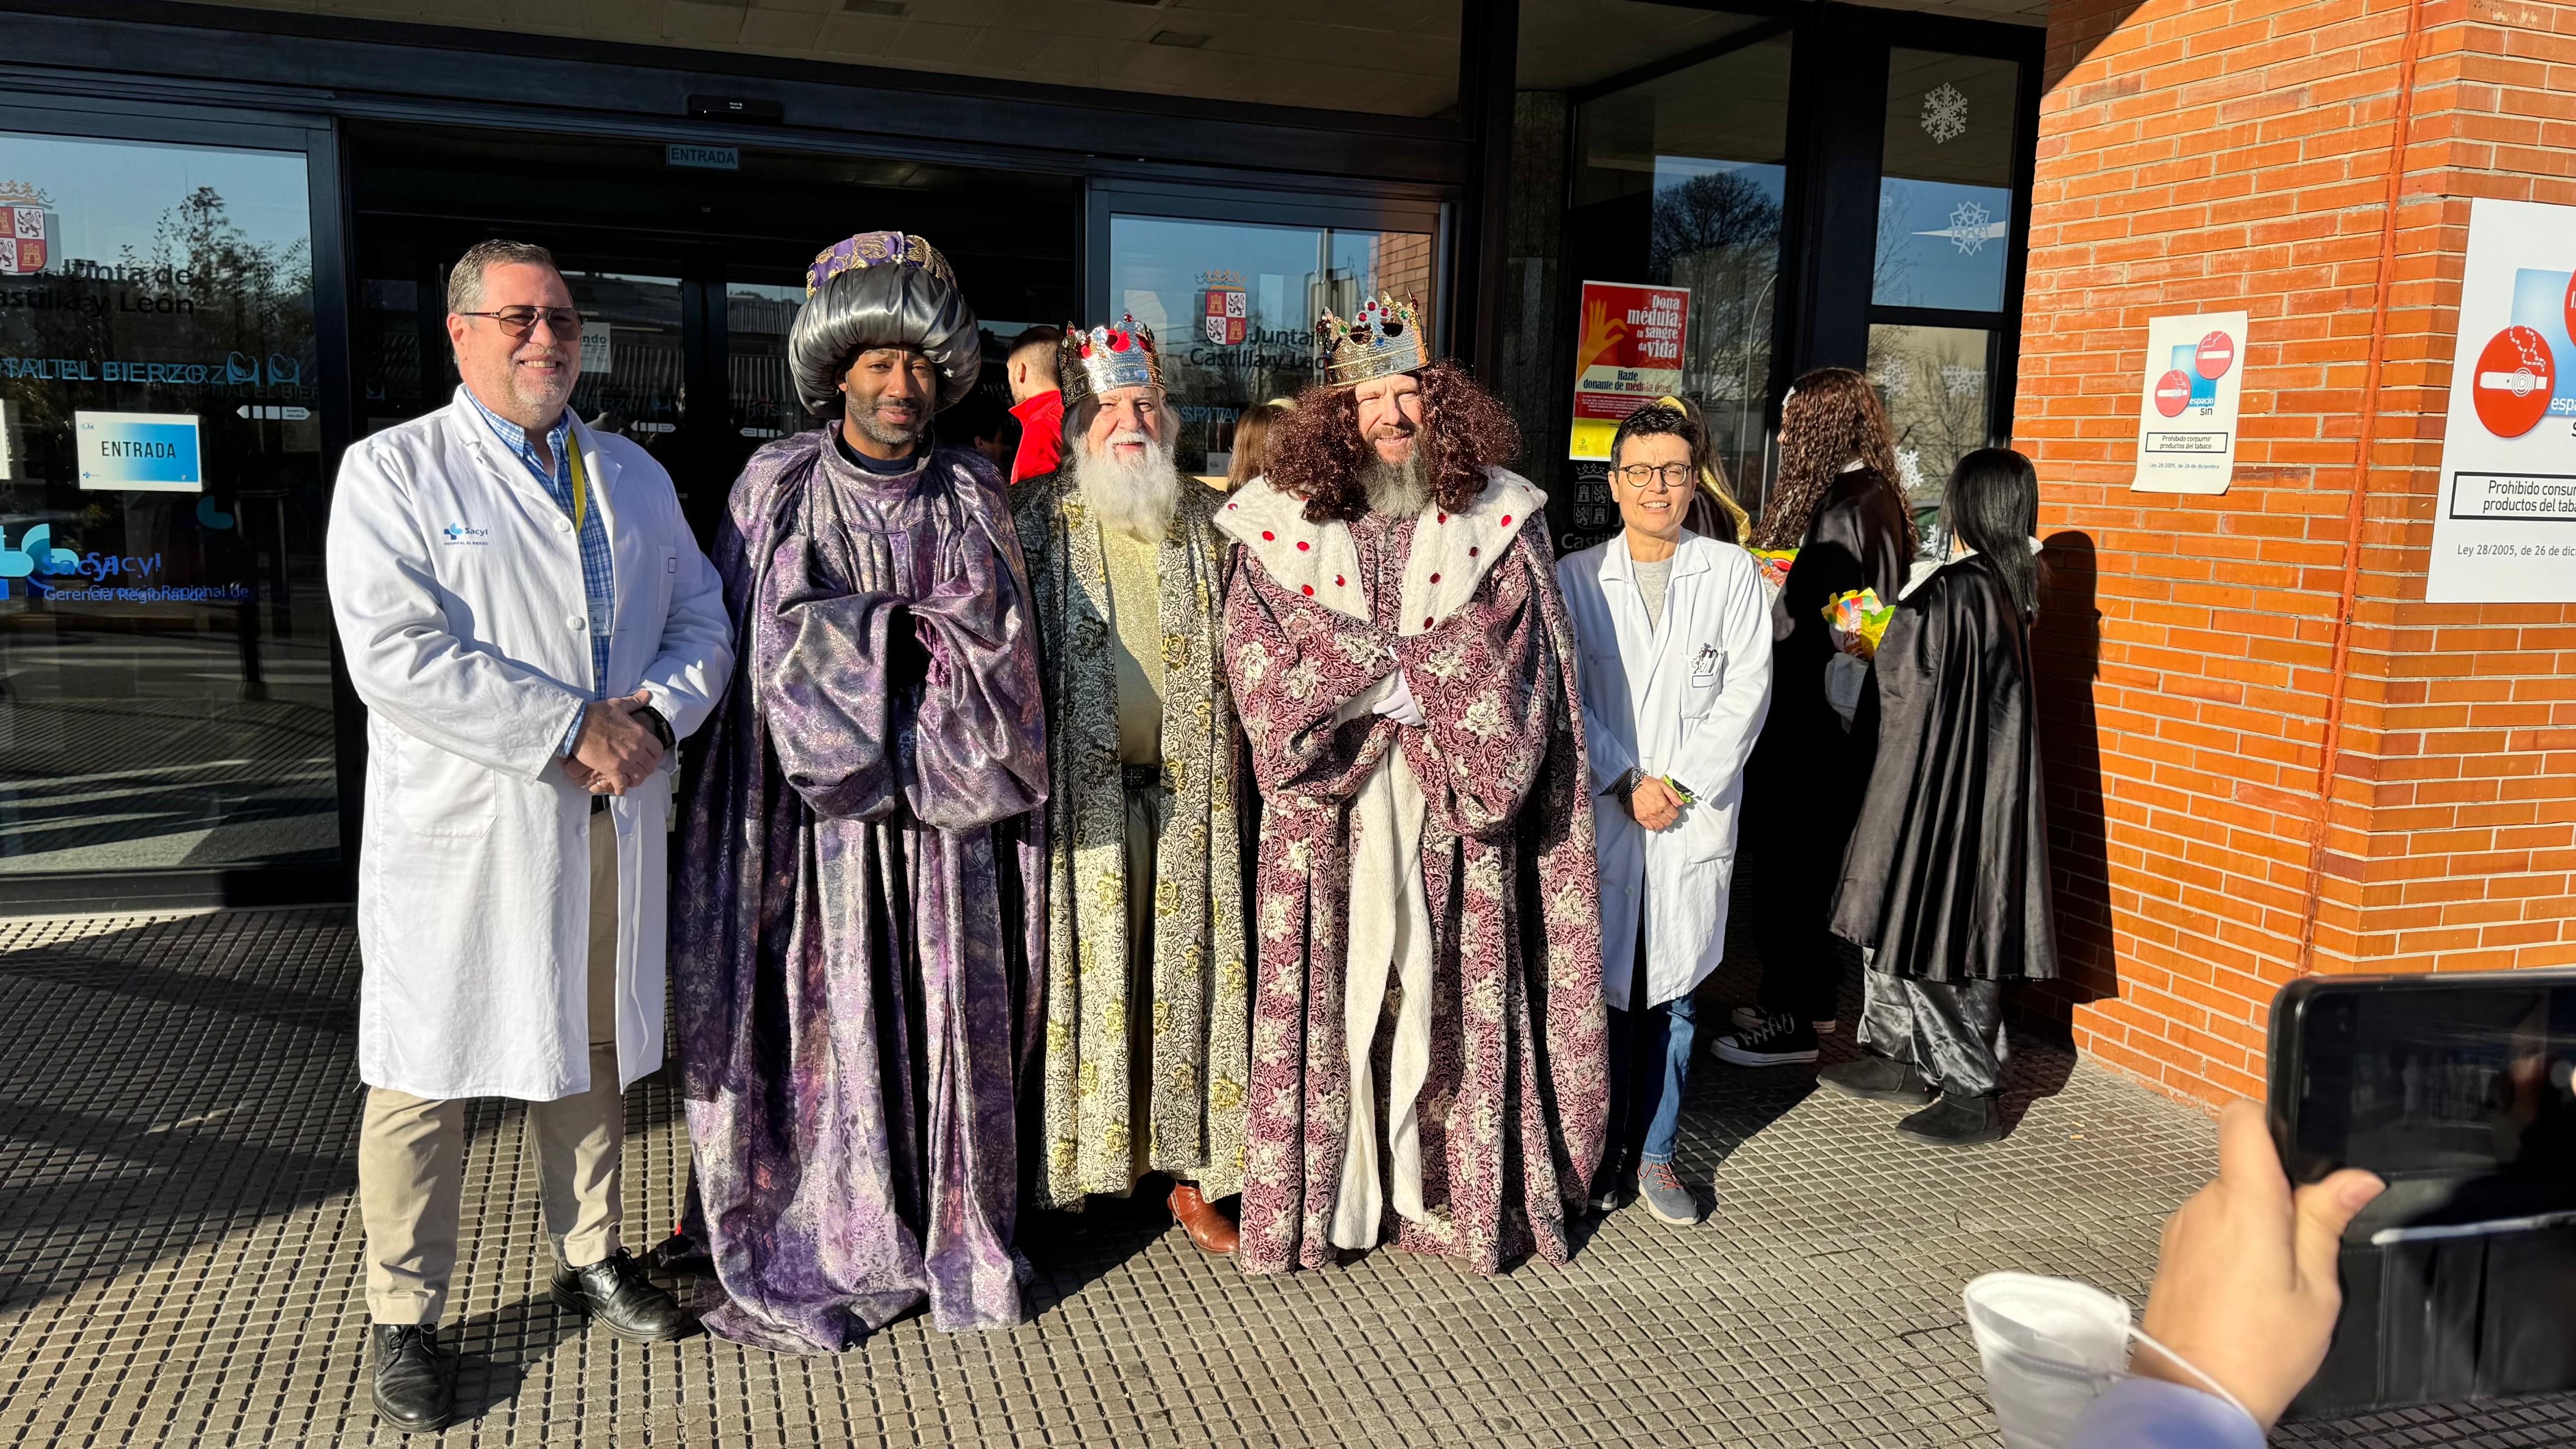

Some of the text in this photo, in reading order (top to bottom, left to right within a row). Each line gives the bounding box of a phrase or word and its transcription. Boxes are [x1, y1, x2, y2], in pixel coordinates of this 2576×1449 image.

[671, 148, 736, 164] ENTRADA
[155, 264, 193, 285] de
[120, 291, 194, 314] León
[1652, 295, 1680, 310] Dona
[1627, 307, 1682, 330] médula,
[1637, 327, 1678, 340] tu sangre
[1638, 340, 1677, 359] da vida
[1617, 370, 1638, 381] Hazte
[1583, 379, 1613, 390] donante
[1615, 381, 1624, 391] de
[2189, 396, 2214, 407] espacio
[2200, 405, 2213, 416] sin
[102, 441, 177, 458] ENTRADA
[2488, 479, 2540, 495] Prohibido
[2483, 497, 2537, 514] productos
[2539, 498, 2555, 512] del
[464, 527, 488, 536] Sacyl
[2457, 544, 2474, 557] Ley
[2476, 544, 2517, 558] 28/2005,
[2521, 545, 2532, 555] de
[2535, 545, 2546, 556] 26
[2548, 545, 2559, 556] de
